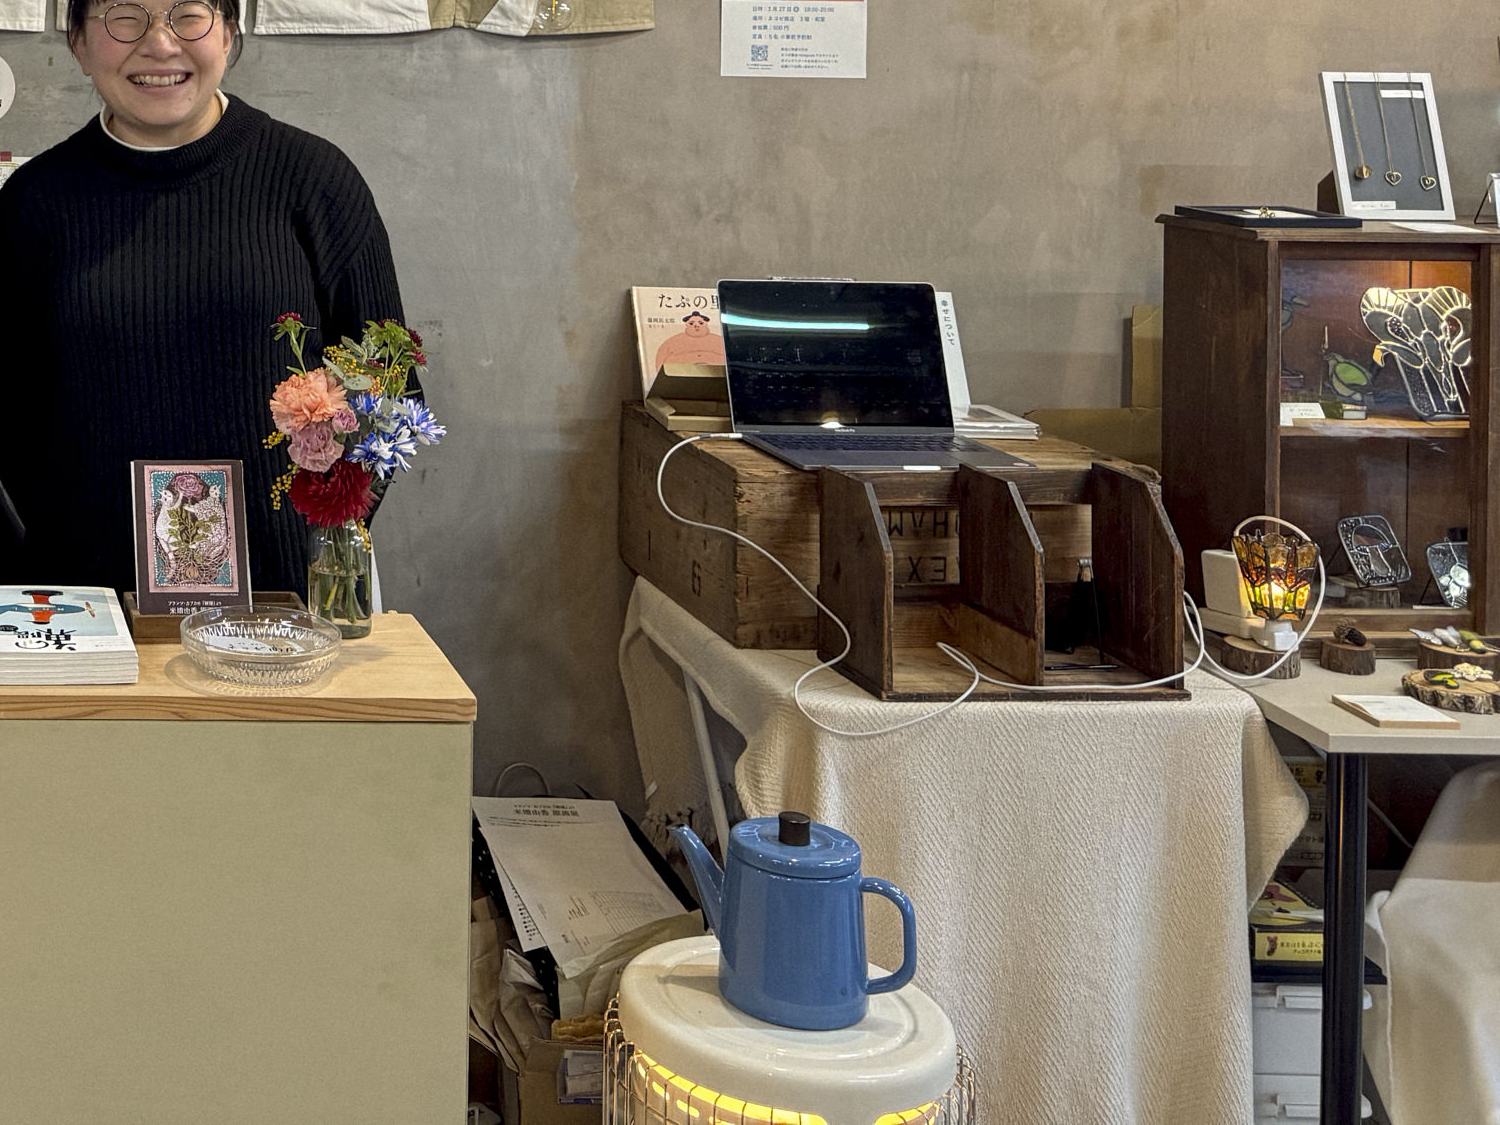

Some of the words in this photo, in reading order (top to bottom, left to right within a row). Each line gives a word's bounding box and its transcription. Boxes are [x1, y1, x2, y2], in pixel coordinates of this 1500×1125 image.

[940, 299, 956, 346] 幸せについて
